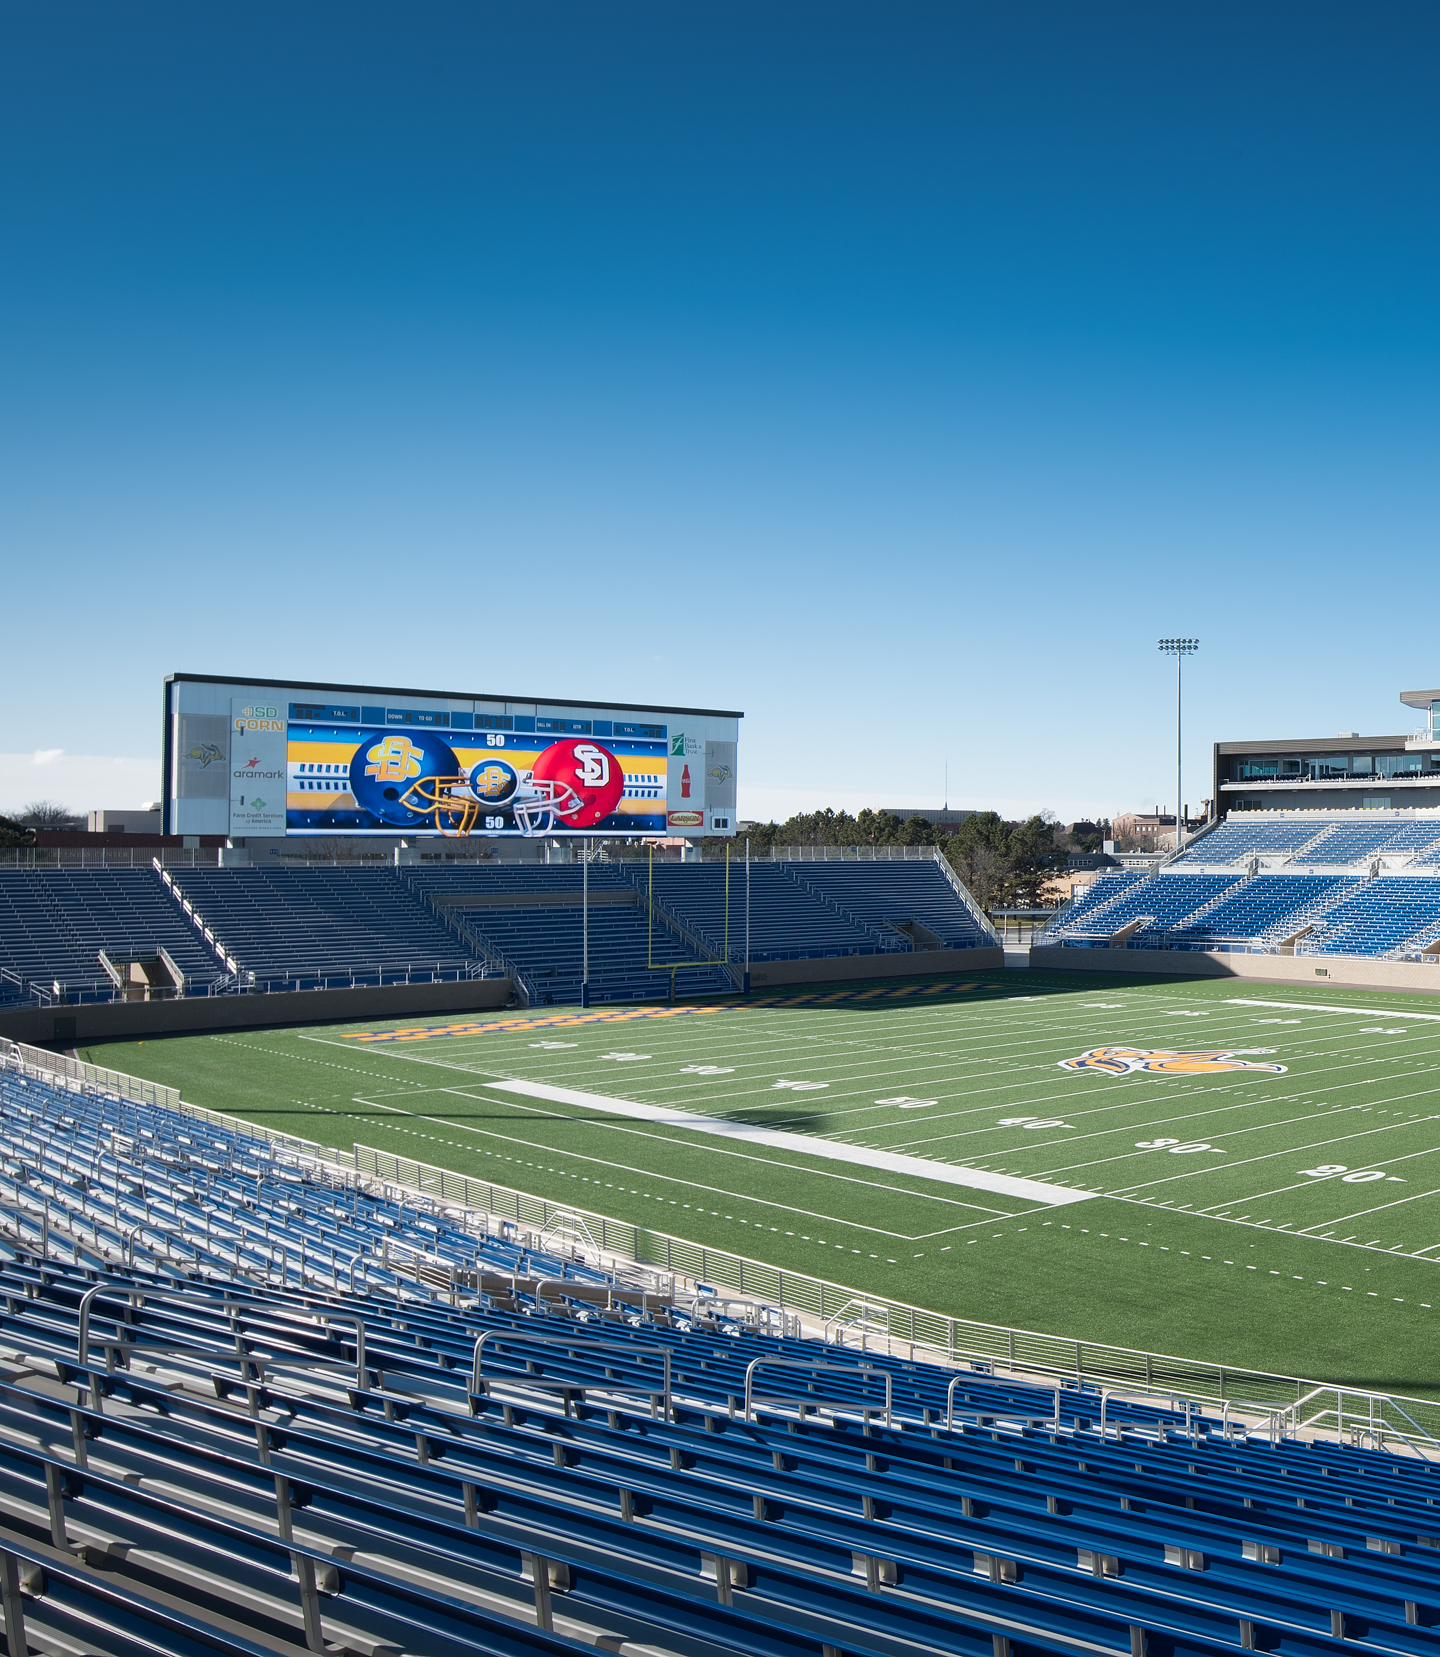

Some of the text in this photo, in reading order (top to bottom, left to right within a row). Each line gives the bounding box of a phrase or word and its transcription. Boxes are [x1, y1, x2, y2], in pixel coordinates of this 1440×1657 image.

[234, 718, 285, 732] CORN
[486, 734, 505, 747] 50
[233, 770, 284, 779] aramark
[485, 816, 504, 829] 50
[874, 1096, 938, 1108] 50
[995, 1116, 1065, 1130] 40
[1134, 1138, 1211, 1154] 30
[1296, 1164, 1386, 1183] 20
